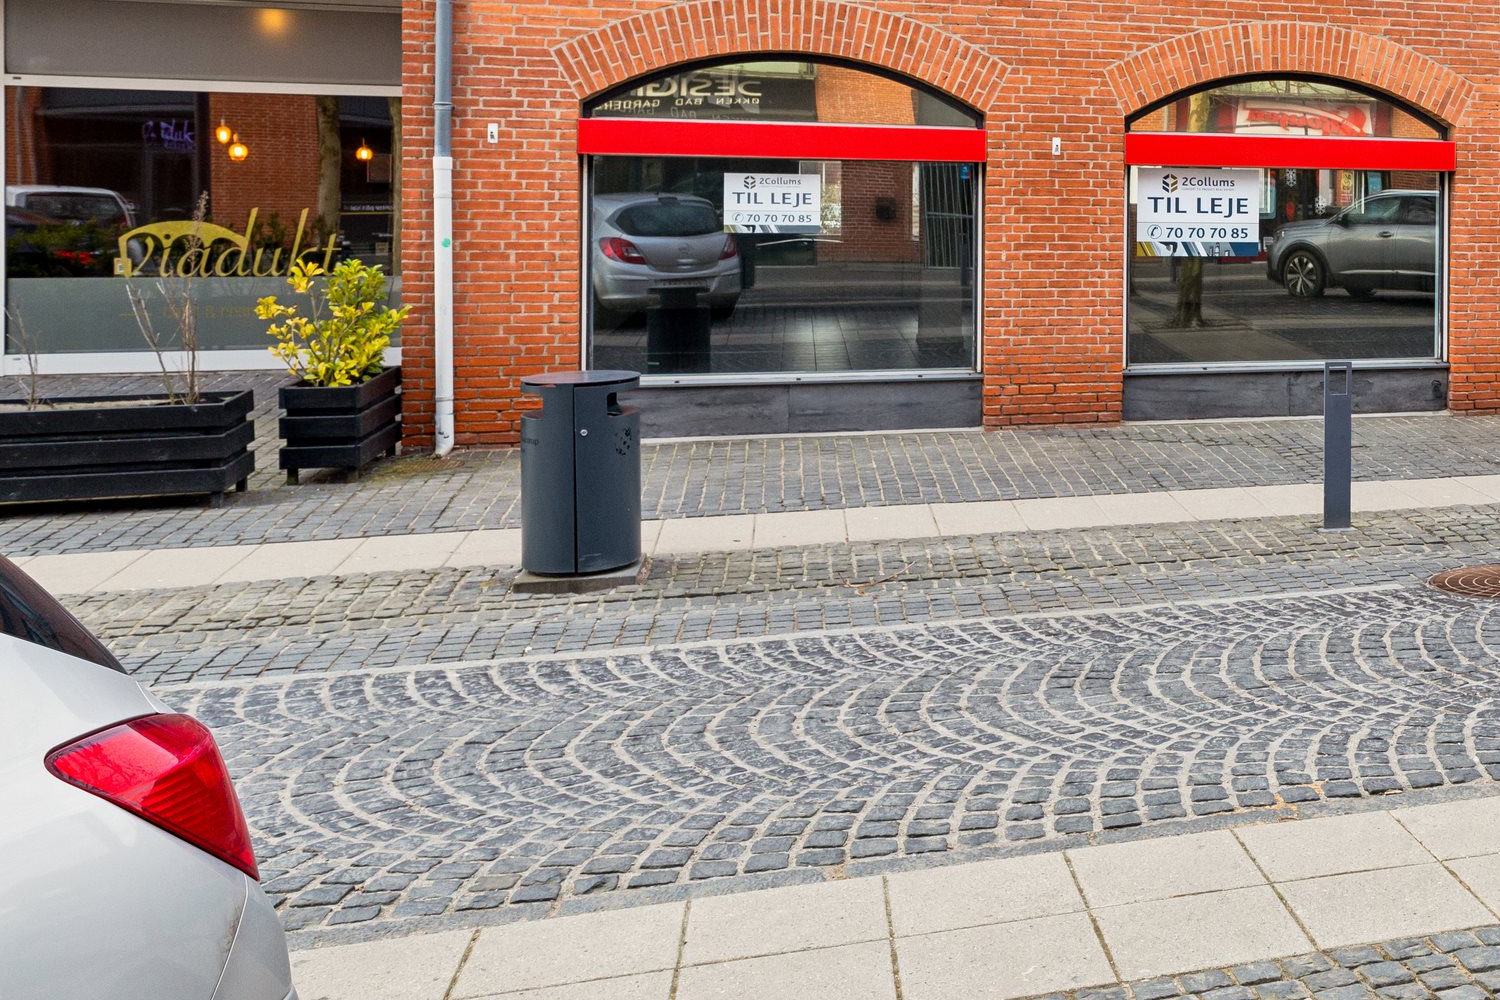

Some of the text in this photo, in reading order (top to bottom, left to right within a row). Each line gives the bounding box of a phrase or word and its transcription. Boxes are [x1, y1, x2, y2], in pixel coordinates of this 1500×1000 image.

[759, 177, 802, 185] 2Collums
[1182, 177, 1235, 187] 2Collums
[732, 192, 812, 207] TIL LEJE
[1147, 197, 1248, 218] TIL LEJE
[746, 214, 812, 223] 70 70 70 85
[1166, 227, 1248, 239] 70 70 70 85
